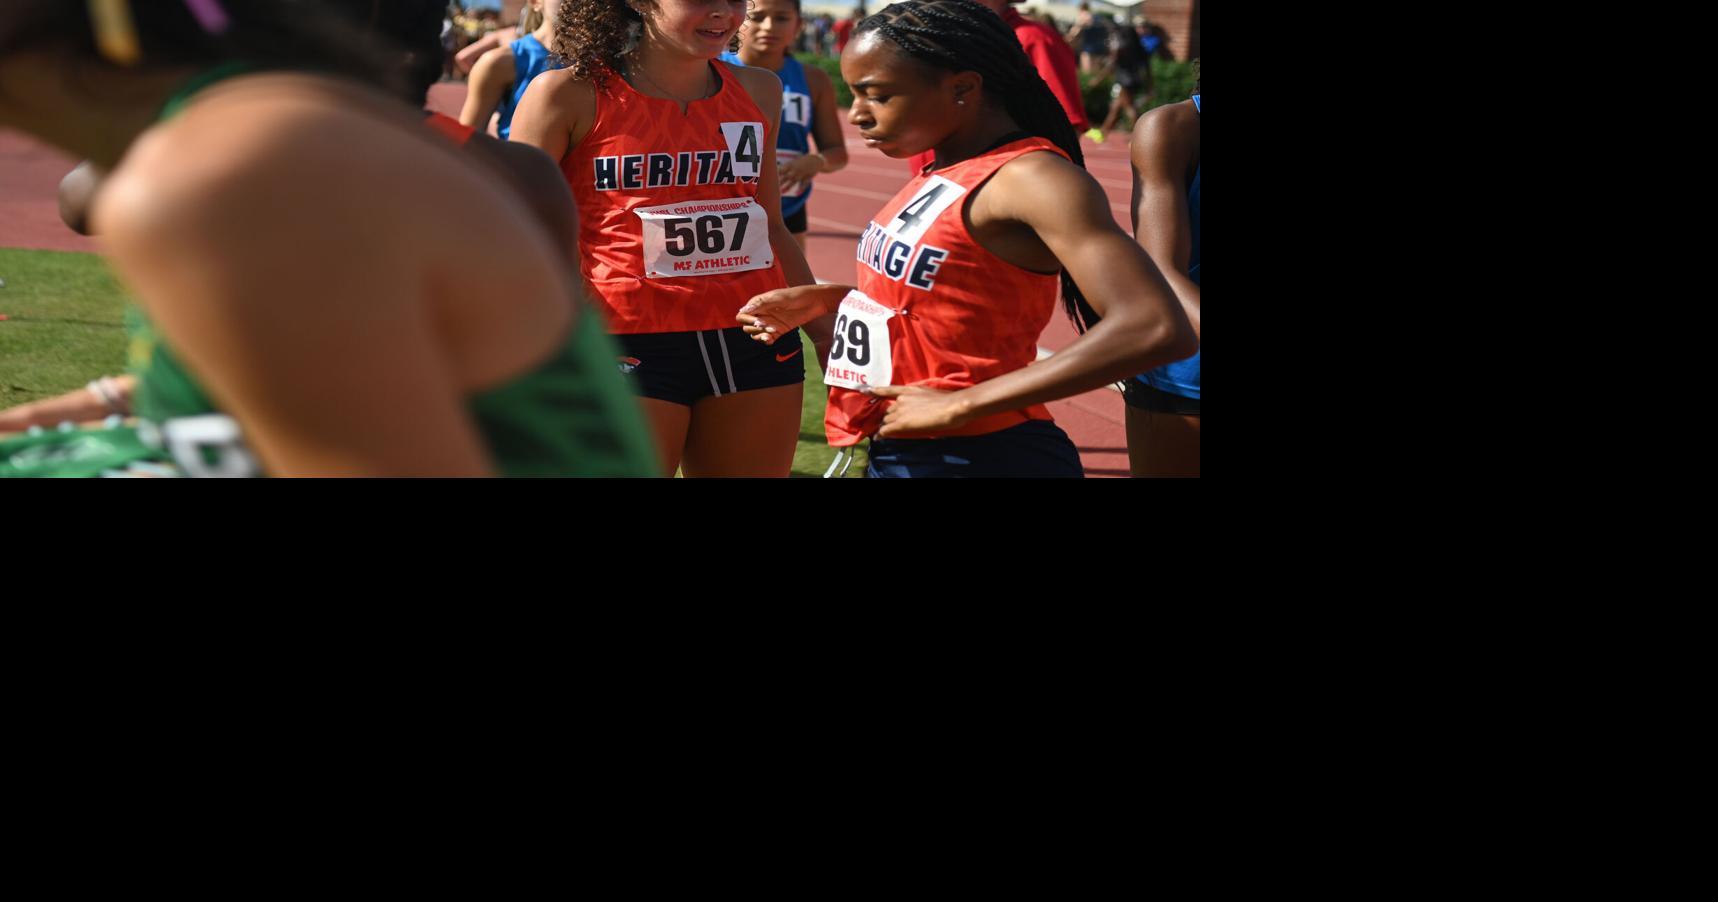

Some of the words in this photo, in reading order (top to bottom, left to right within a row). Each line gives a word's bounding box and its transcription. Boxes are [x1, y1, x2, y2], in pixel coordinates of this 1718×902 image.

[593, 150, 759, 192] HERITA
[735, 125, 760, 173] 4
[896, 183, 949, 234] 4
[664, 212, 750, 257] 567
[694, 255, 750, 270] ATHLETIC
